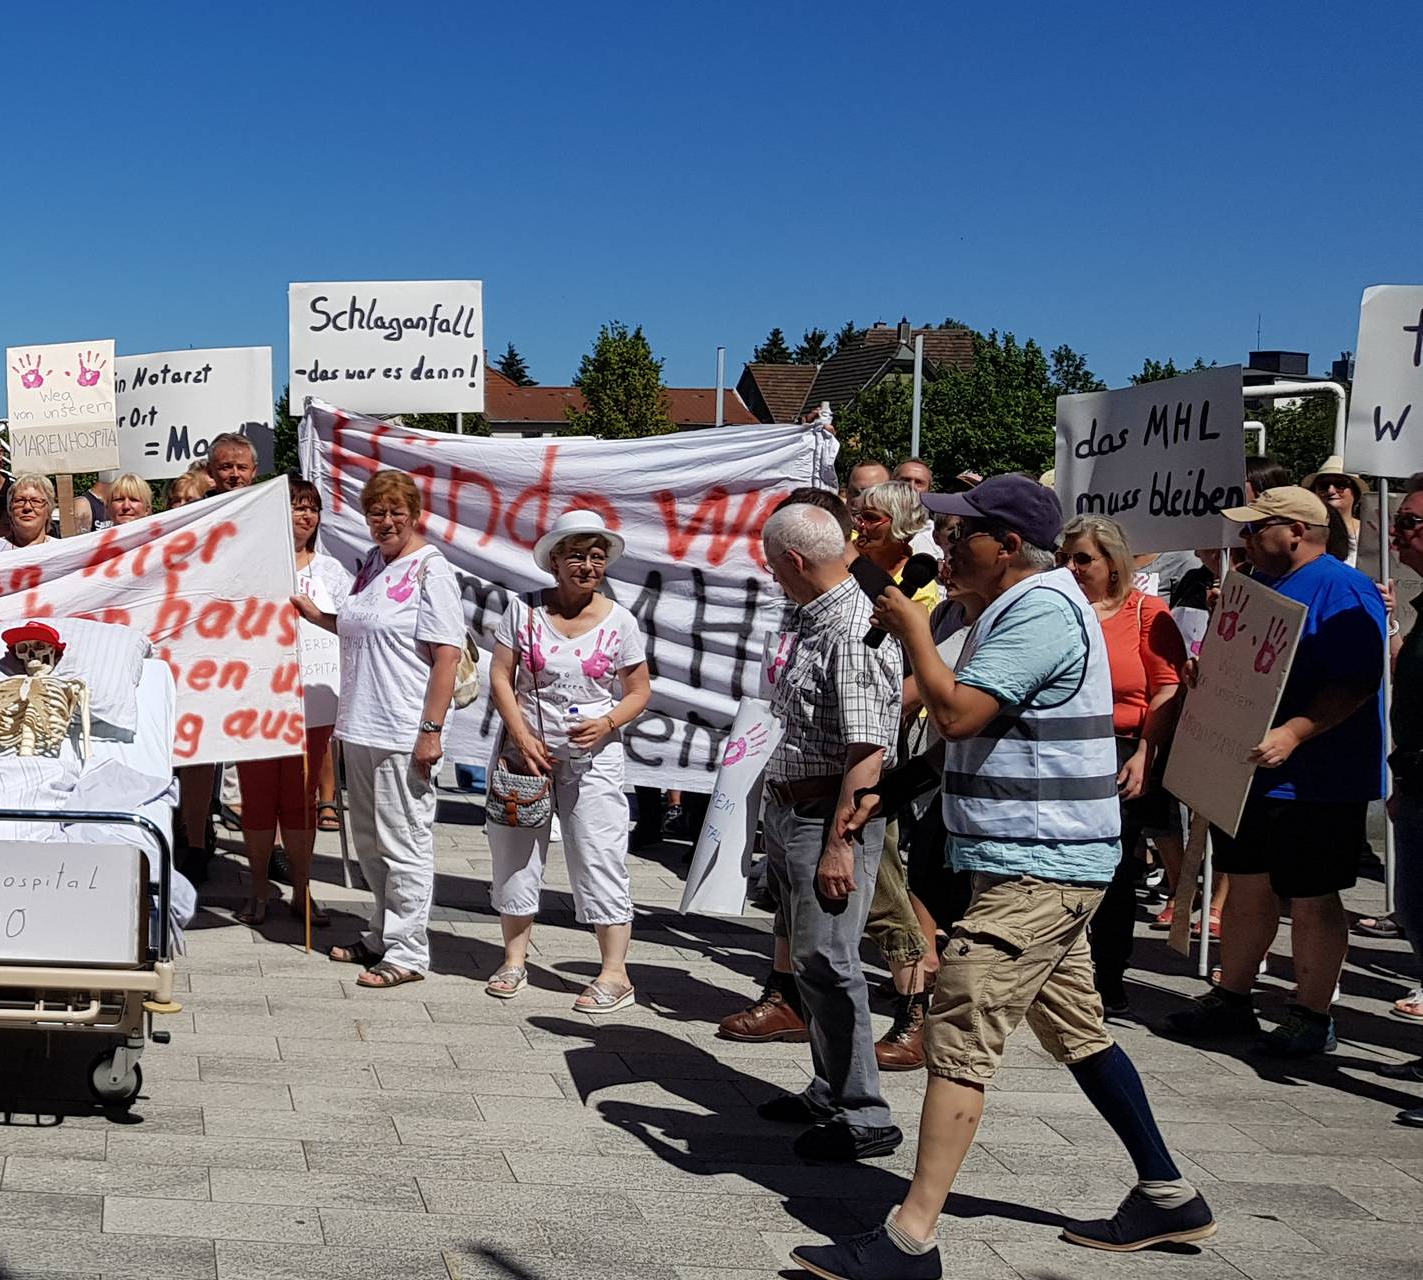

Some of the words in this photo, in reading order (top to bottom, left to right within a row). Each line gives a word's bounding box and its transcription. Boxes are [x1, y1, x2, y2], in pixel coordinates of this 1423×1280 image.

[309, 295, 475, 341] Schlaganfall
[114, 371, 126, 393] in
[132, 364, 212, 390] Notarzt
[344, 367, 376, 380] war
[382, 367, 403, 380] es
[409, 354, 478, 388] dann!
[13, 409, 34, 420] von
[43, 401, 113, 419] unserem
[39, 388, 74, 409] Weg
[130, 405, 158, 428] Ort
[1075, 418, 1129, 459] das
[1143, 400, 1221, 449] MHL
[11, 428, 118, 457] MARIENHOSPITA
[1076, 488, 1141, 515] muss
[82, 520, 237, 579] hier
